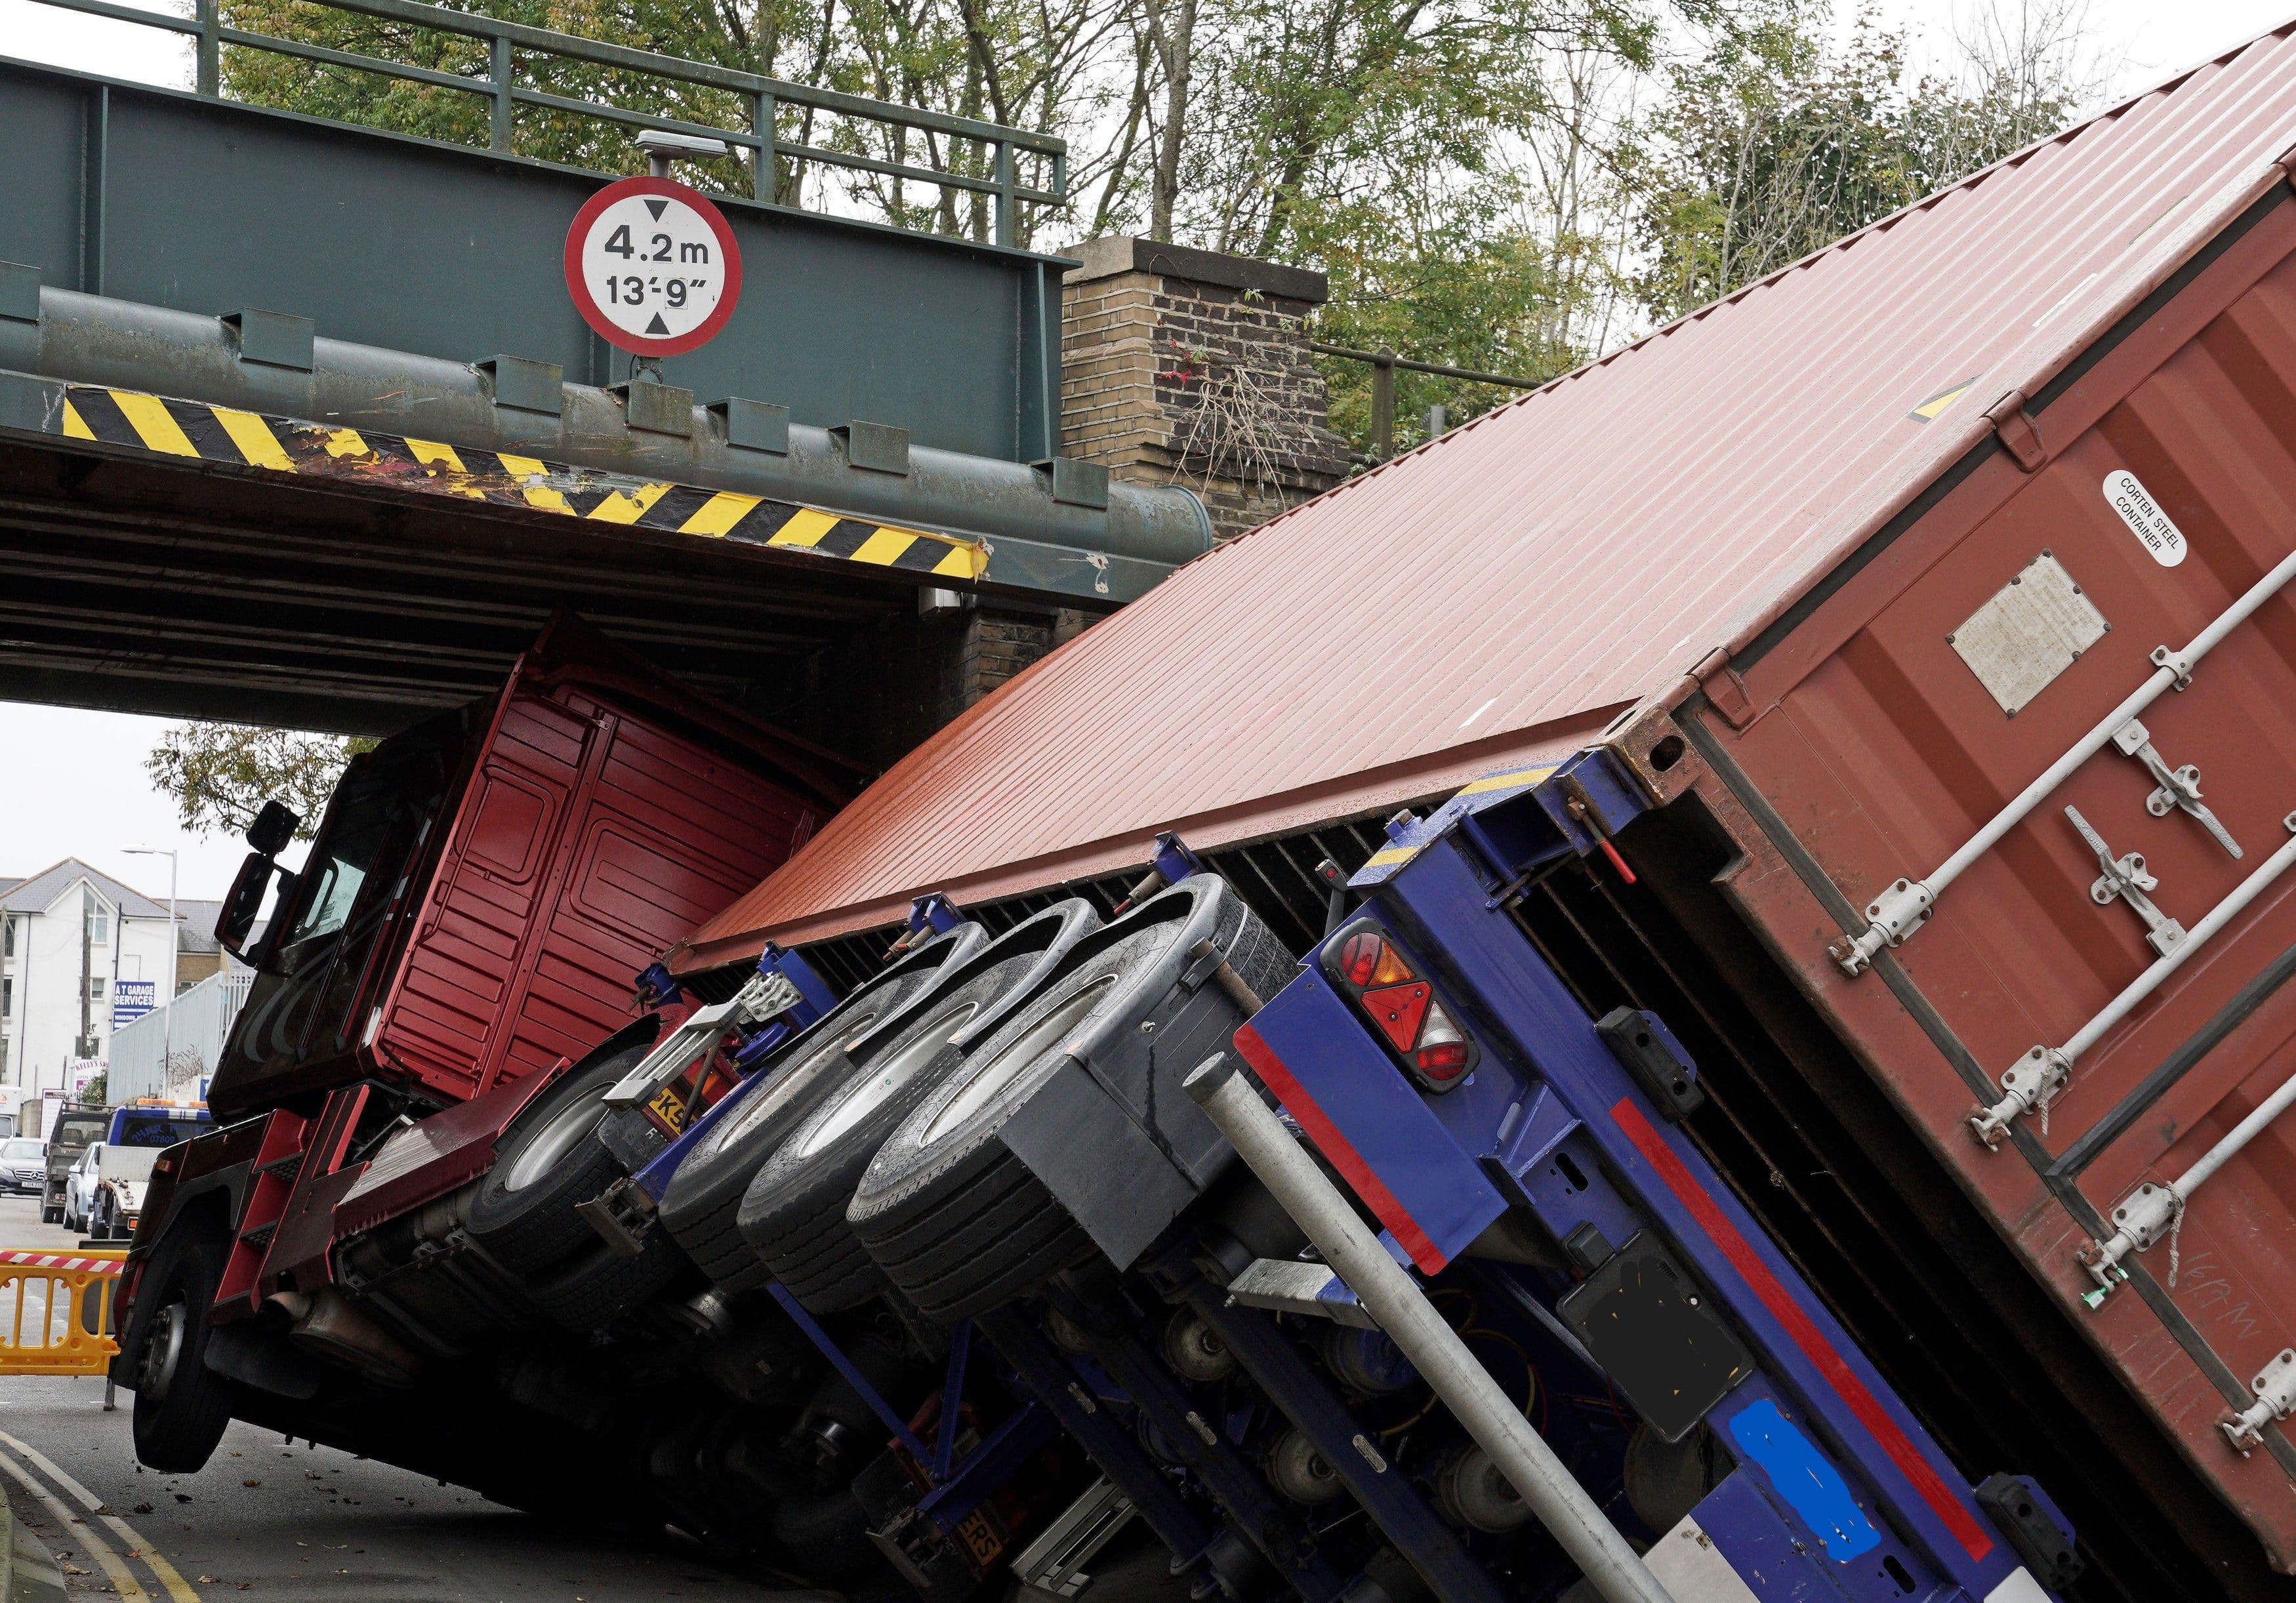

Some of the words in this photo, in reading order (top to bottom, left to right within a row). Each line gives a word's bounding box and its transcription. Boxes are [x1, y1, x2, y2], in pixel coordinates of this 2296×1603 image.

[2116, 497, 2162, 551] CONTAINER
[2121, 477, 2155, 517] CORTEN
[2153, 517, 2179, 550] STEEL
[114, 995, 154, 1005] SERVICES
[115, 984, 120, 995] A
[121, 984, 127, 995] T
[127, 984, 154, 996] GARAGE
